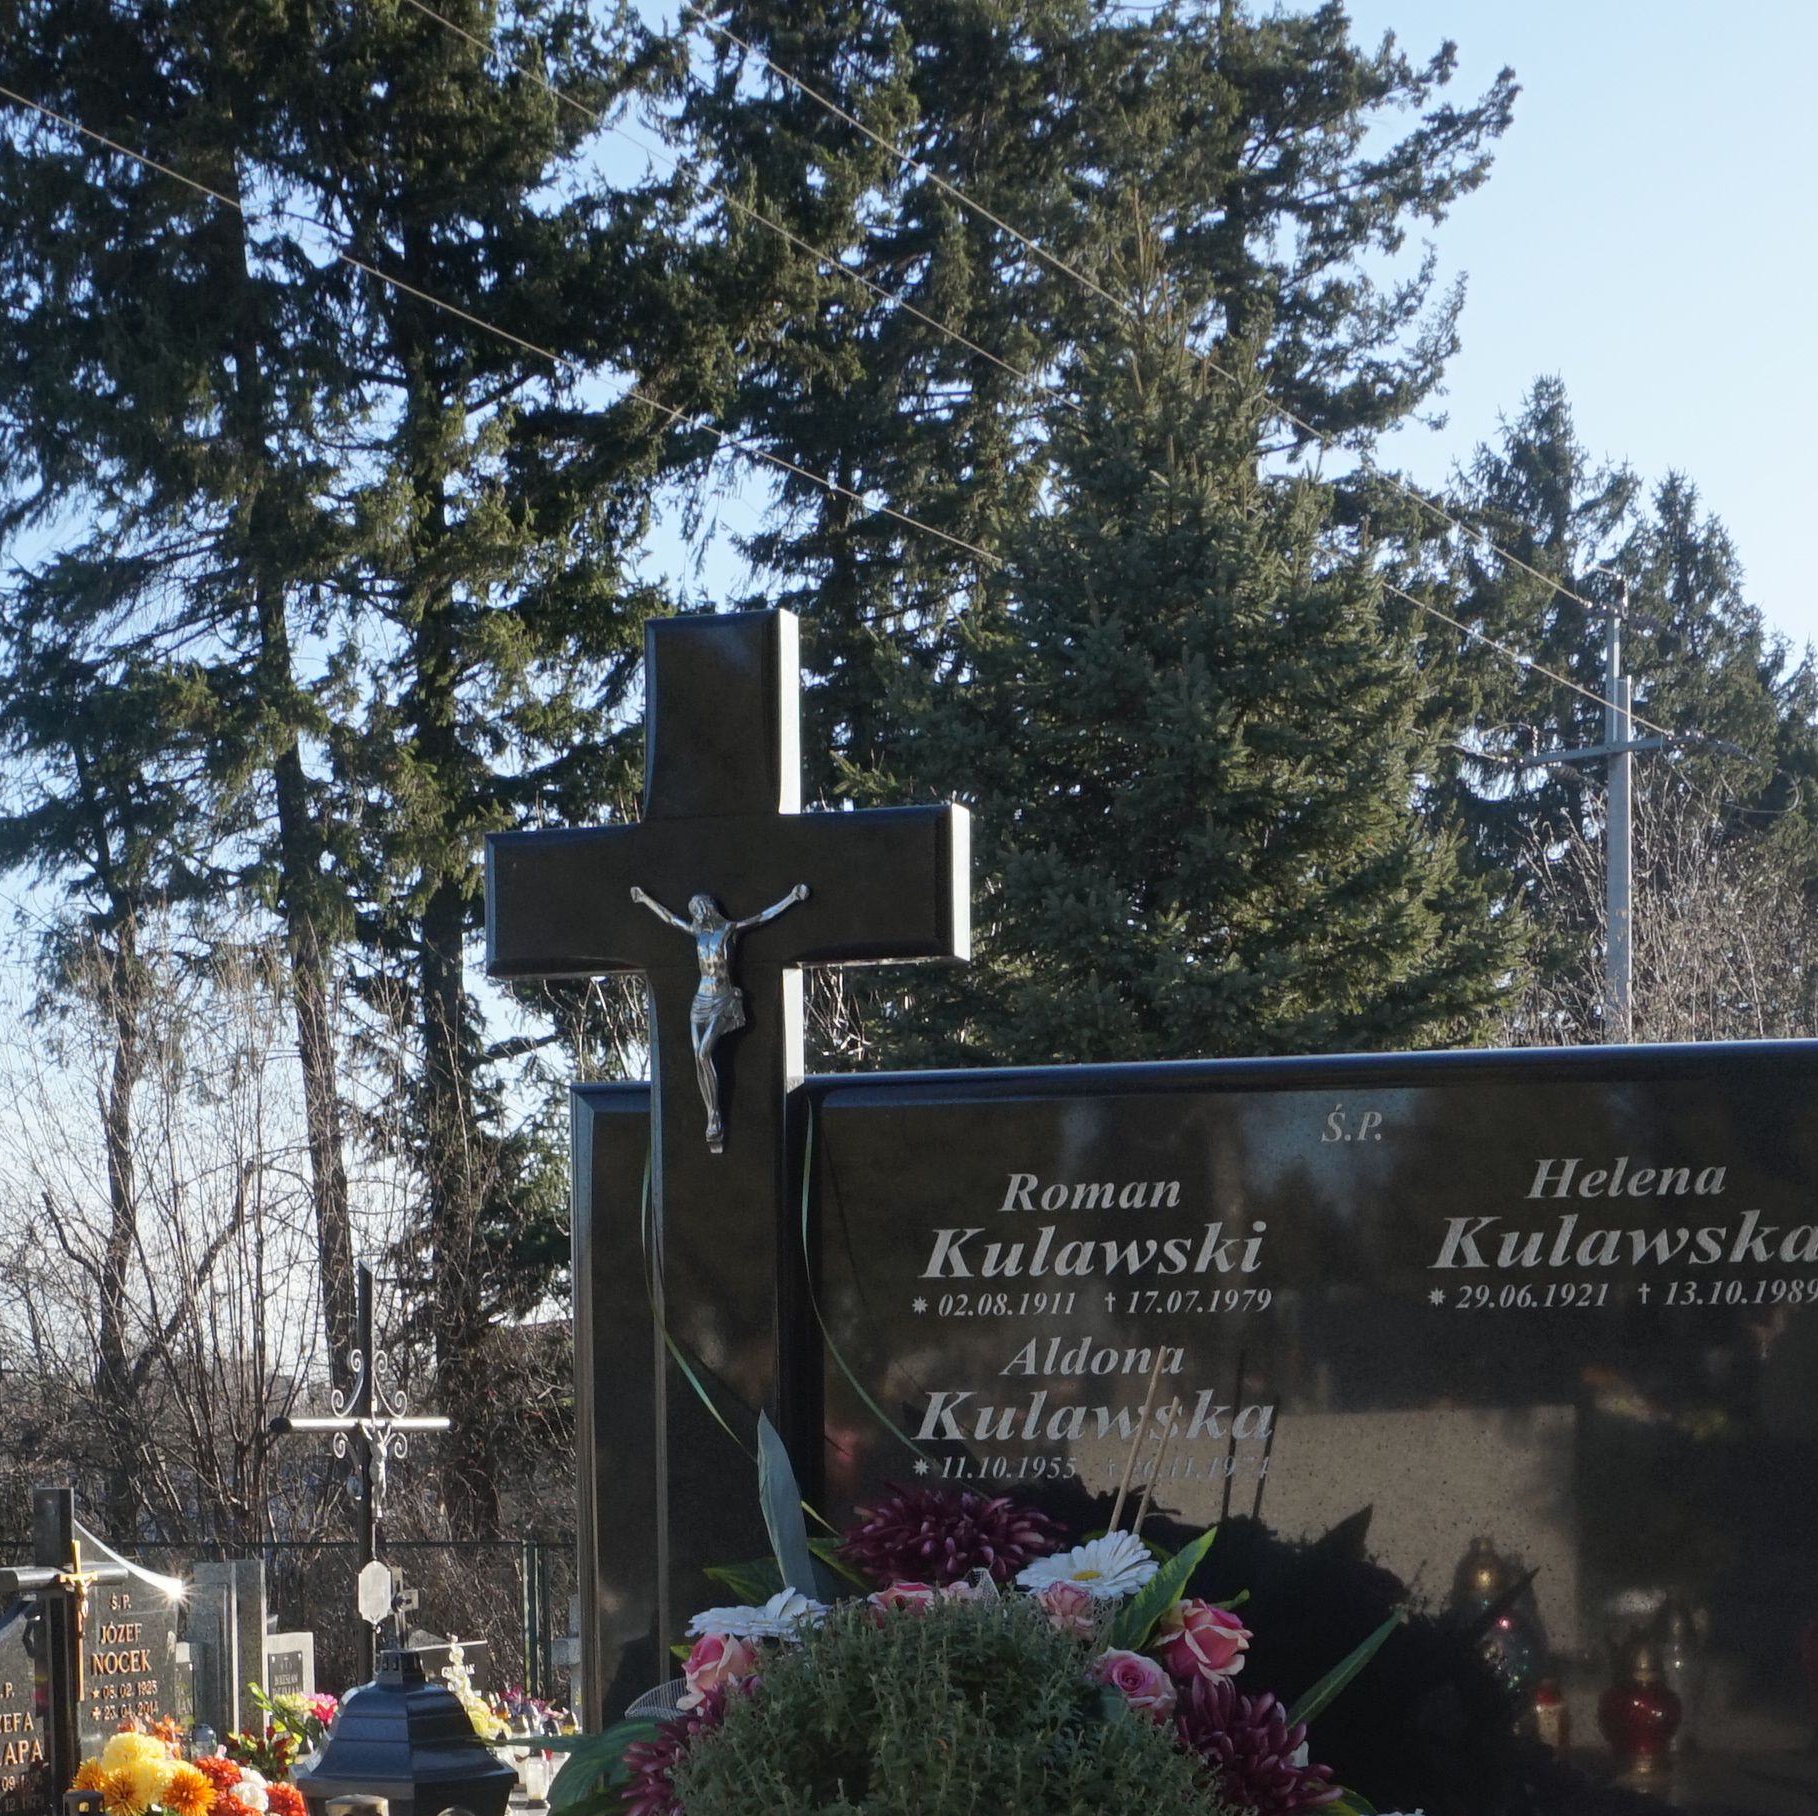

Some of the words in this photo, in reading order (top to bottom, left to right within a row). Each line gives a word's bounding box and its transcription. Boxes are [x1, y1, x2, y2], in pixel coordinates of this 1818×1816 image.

[1320, 1101, 1383, 1143] Ś.P.
[997, 1172, 1182, 1213] Roman
[1523, 1156, 1728, 1200] Helena
[916, 1219, 1268, 1280] Kulawski
[937, 1290, 1077, 1318] 02.08.1911
[1125, 1287, 1273, 1315] 17.07.1979
[1454, 1282, 1610, 1311] 29.06.1921
[998, 1335, 1186, 1377] Aldona
[909, 1388, 1277, 1441] Kulawska
[941, 1454, 1078, 1480] 11.10.1955
[100, 1621, 143, 1645] JÓZEF
[91, 1648, 153, 1677] NOCEK
